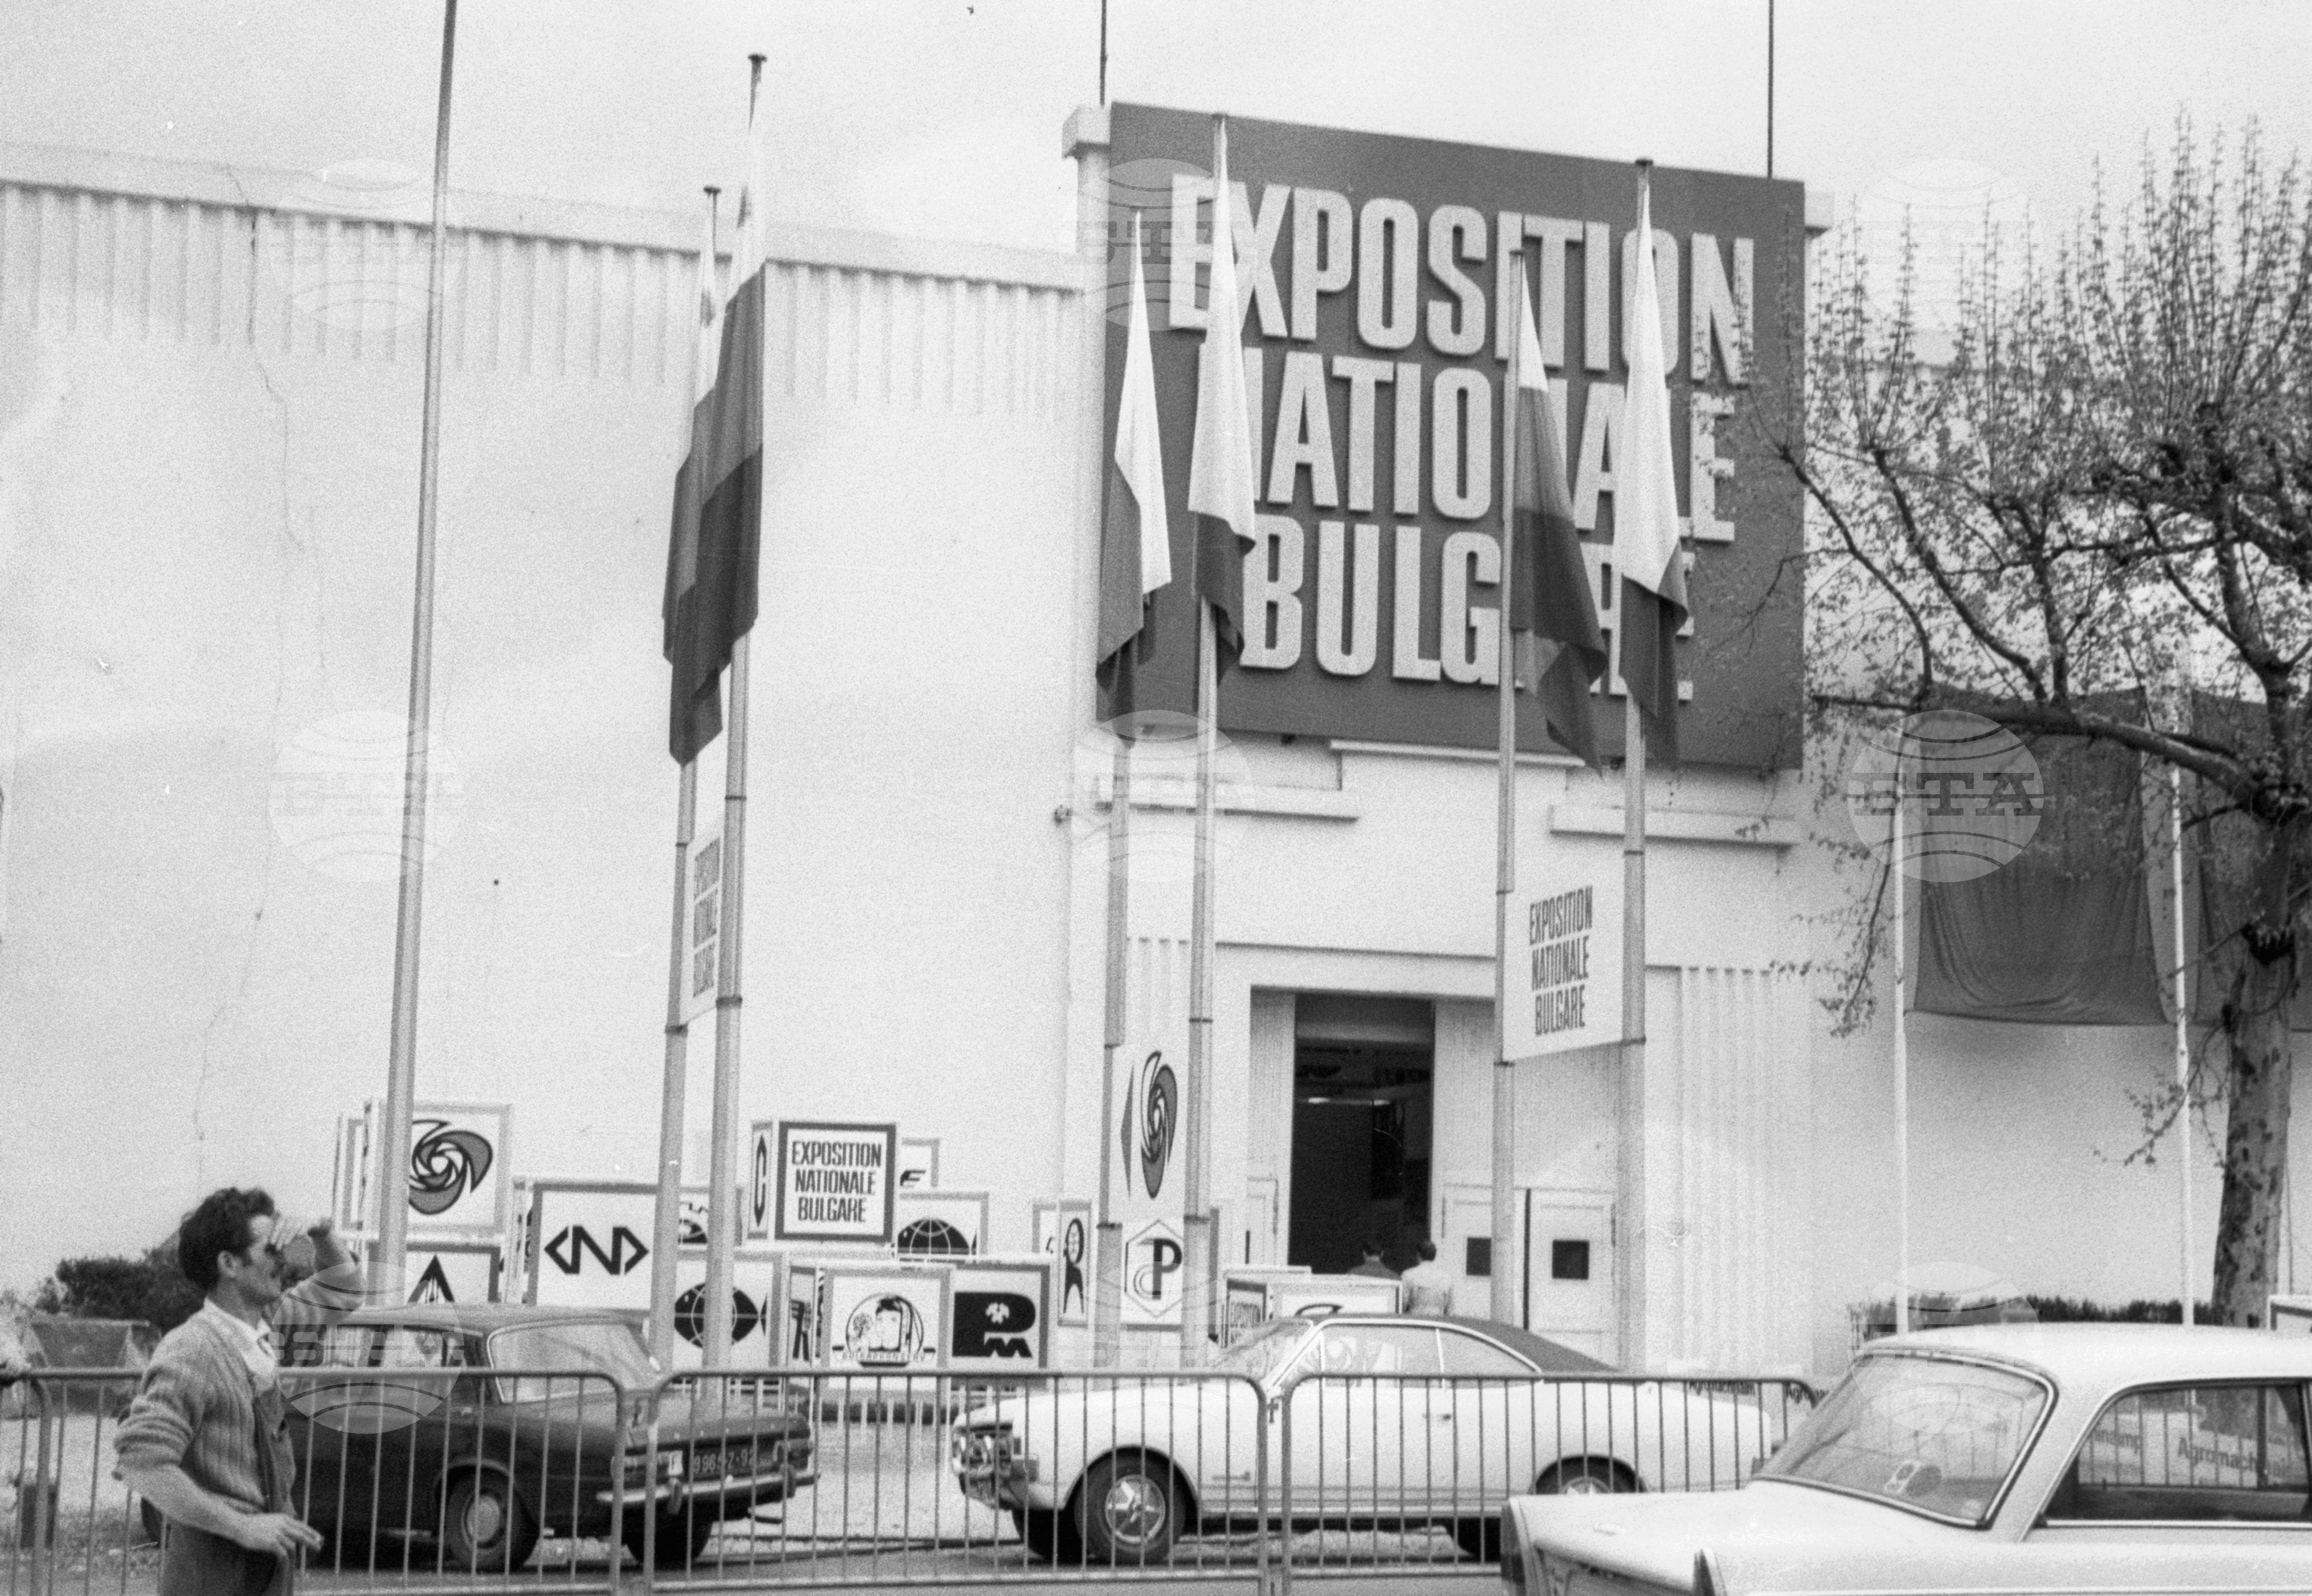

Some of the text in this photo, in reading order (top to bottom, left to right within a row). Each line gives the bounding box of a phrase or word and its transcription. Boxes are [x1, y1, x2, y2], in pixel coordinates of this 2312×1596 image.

[1529, 885, 1593, 946] EXPOSITION
[1532, 935, 1589, 991] NATIONALE
[1535, 984, 1585, 1036] BULGARE
[792, 1140, 881, 1168] EXPOSITION
[795, 1168, 876, 1195] NATIONALE
[798, 1197, 866, 1223] BULGARE
